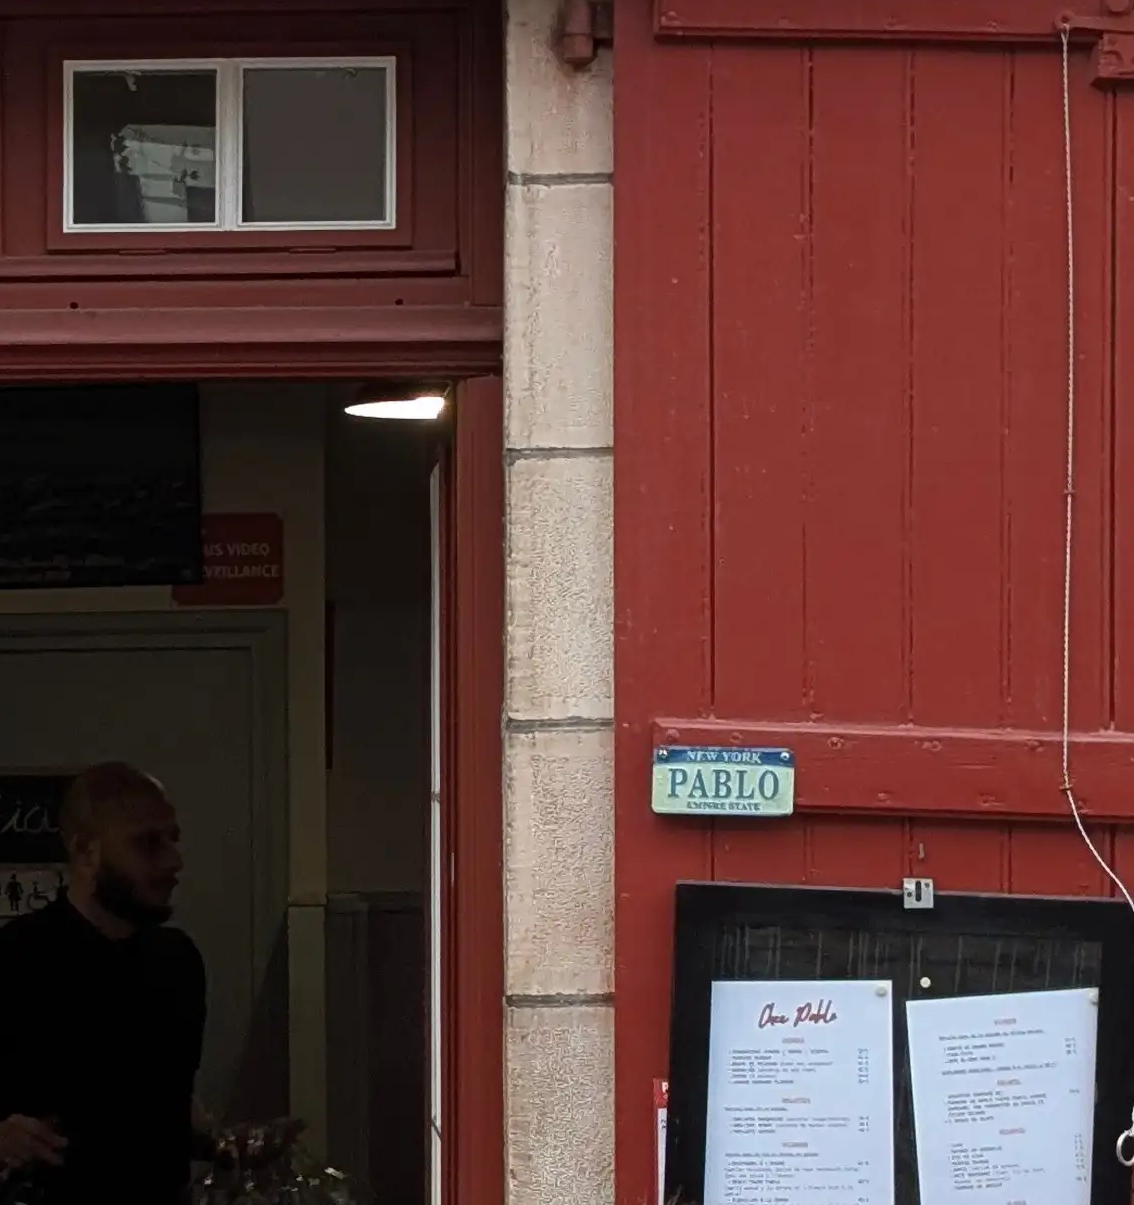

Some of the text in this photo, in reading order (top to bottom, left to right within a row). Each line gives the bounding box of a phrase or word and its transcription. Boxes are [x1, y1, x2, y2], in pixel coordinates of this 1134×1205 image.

[226, 542, 271, 557] VIDEO
[685, 750, 762, 764] NEW YORK
[667, 768, 780, 801] PABLO
